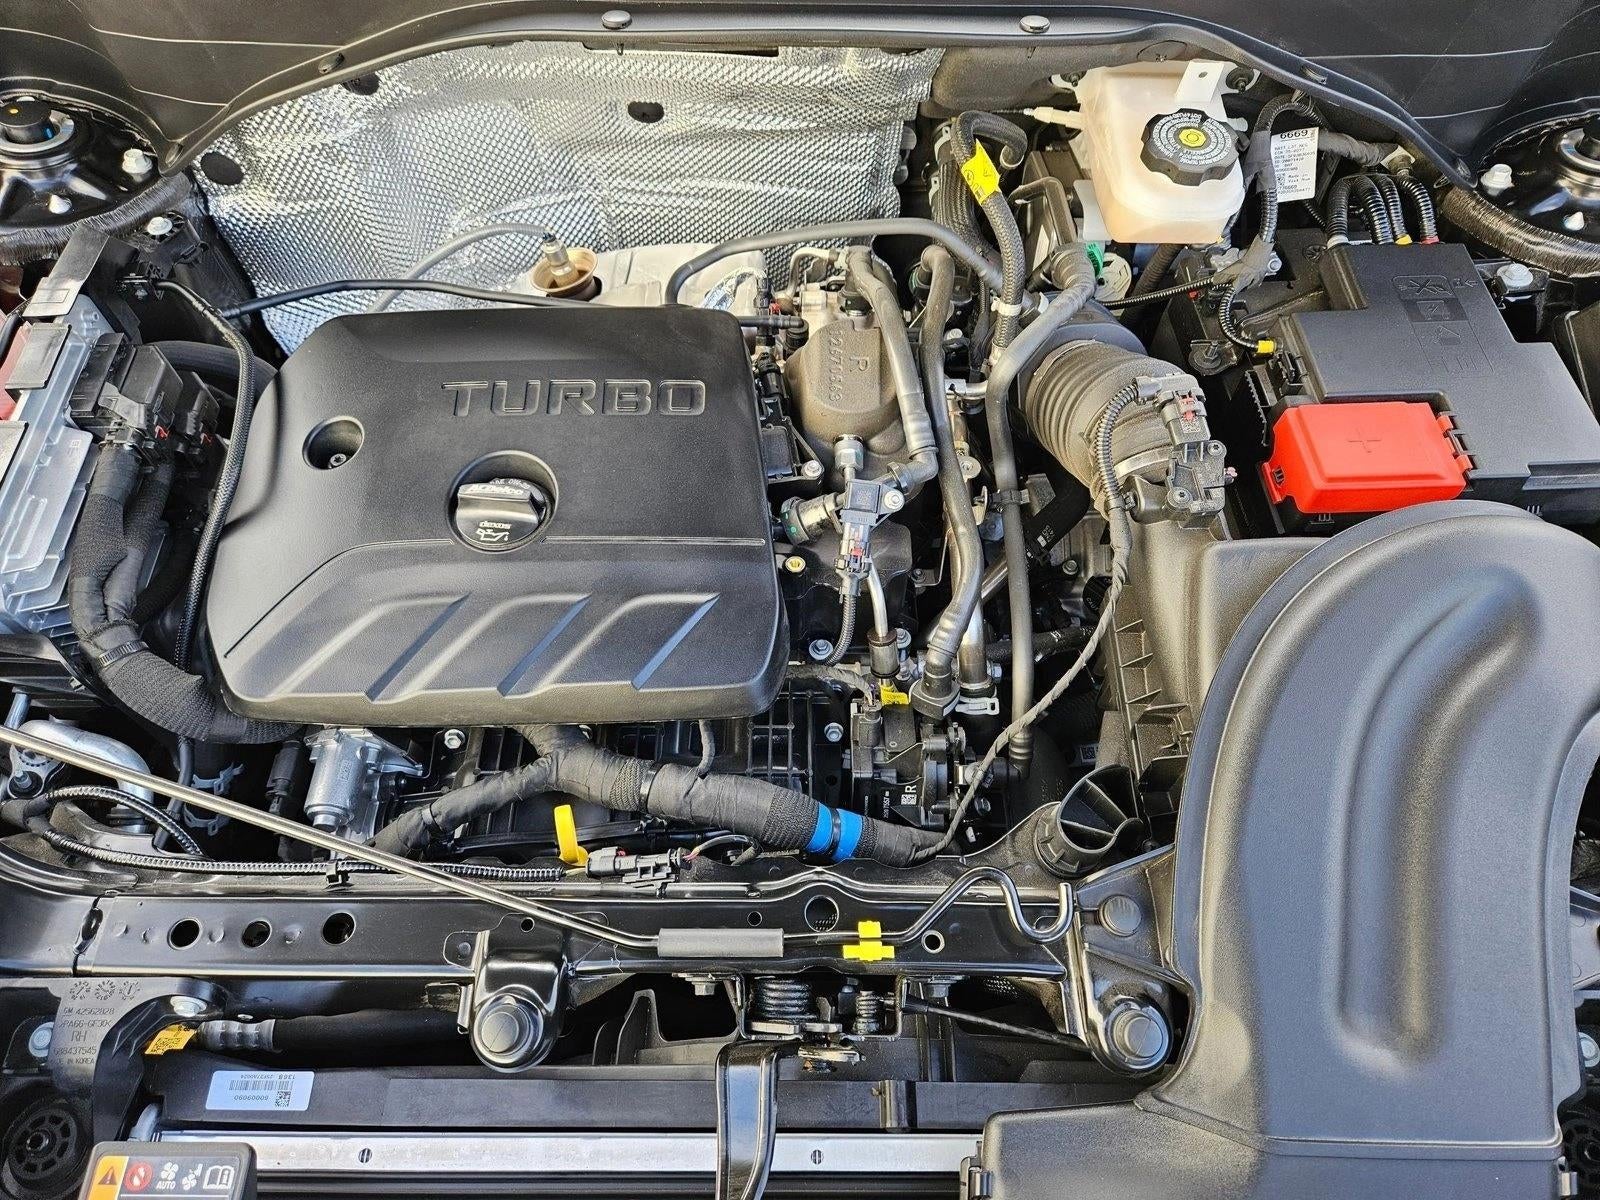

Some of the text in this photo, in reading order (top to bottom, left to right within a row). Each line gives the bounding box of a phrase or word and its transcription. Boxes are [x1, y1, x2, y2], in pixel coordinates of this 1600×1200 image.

[1280, 129, 1308, 139] 6669
[850, 357, 869, 372] R
[441, 378, 706, 417] TURBO
[479, 520, 512, 530] dexos
[904, 785, 917, 793] R
[71, 1030, 88, 1042] RH
[156, 1180, 176, 1190] AUTO
